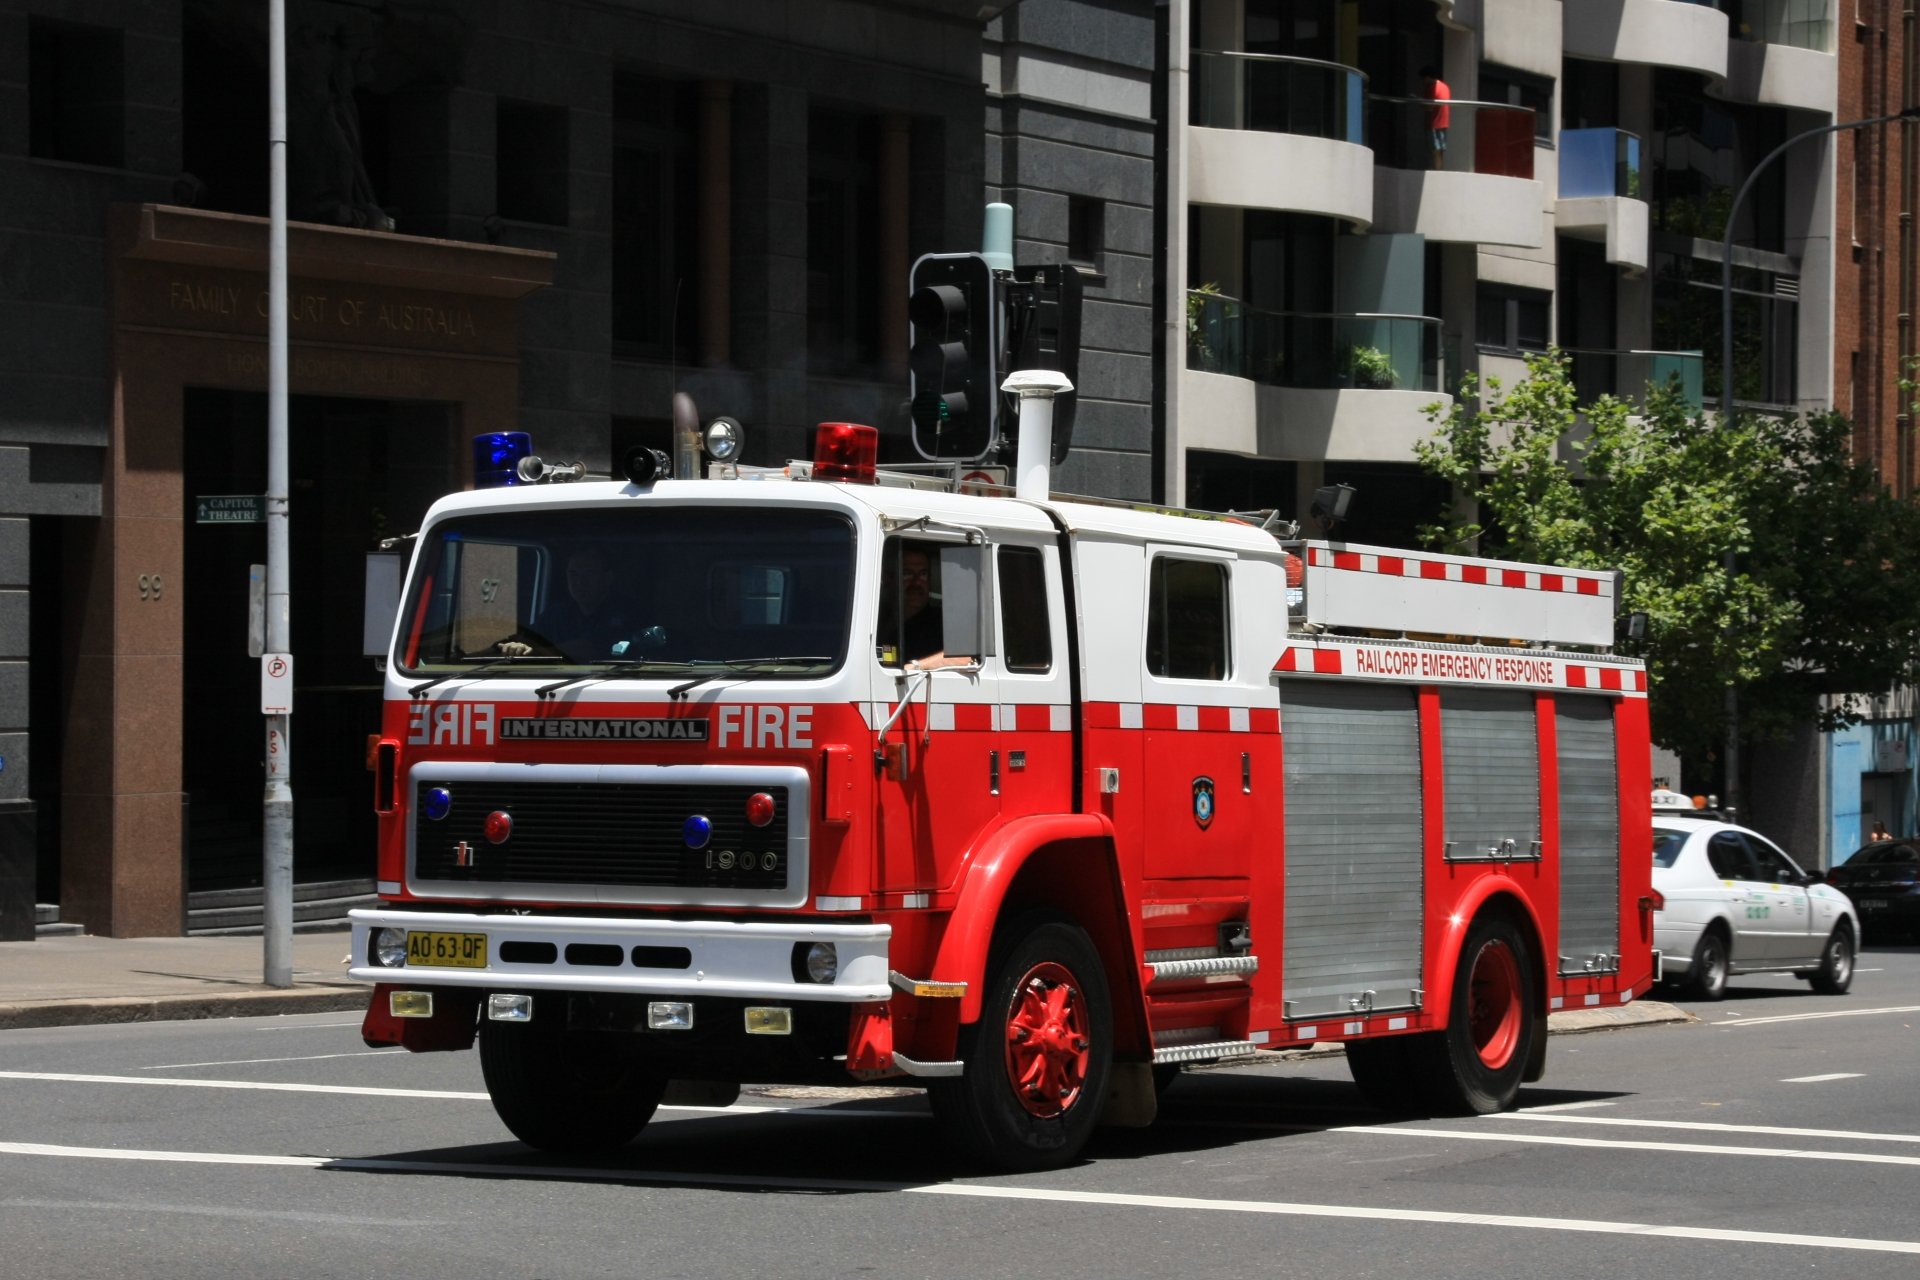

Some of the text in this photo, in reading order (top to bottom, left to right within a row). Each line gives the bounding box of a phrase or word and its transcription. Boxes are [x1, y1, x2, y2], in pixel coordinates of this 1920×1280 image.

[170, 282, 475, 337] FAMILY CURT OF AUSTRALIA
[208, 510, 258, 520] THEATRE
[210, 499, 257, 508] CAPITOL
[138, 574, 162, 602] 99
[481, 578, 501, 603] 97
[1357, 649, 1553, 684] RAILCORP EMERGENCY RESPONSE
[503, 719, 703, 738] INTERNATIONAL
[718, 705, 814, 748] FIRE
[706, 849, 777, 871] 1900
